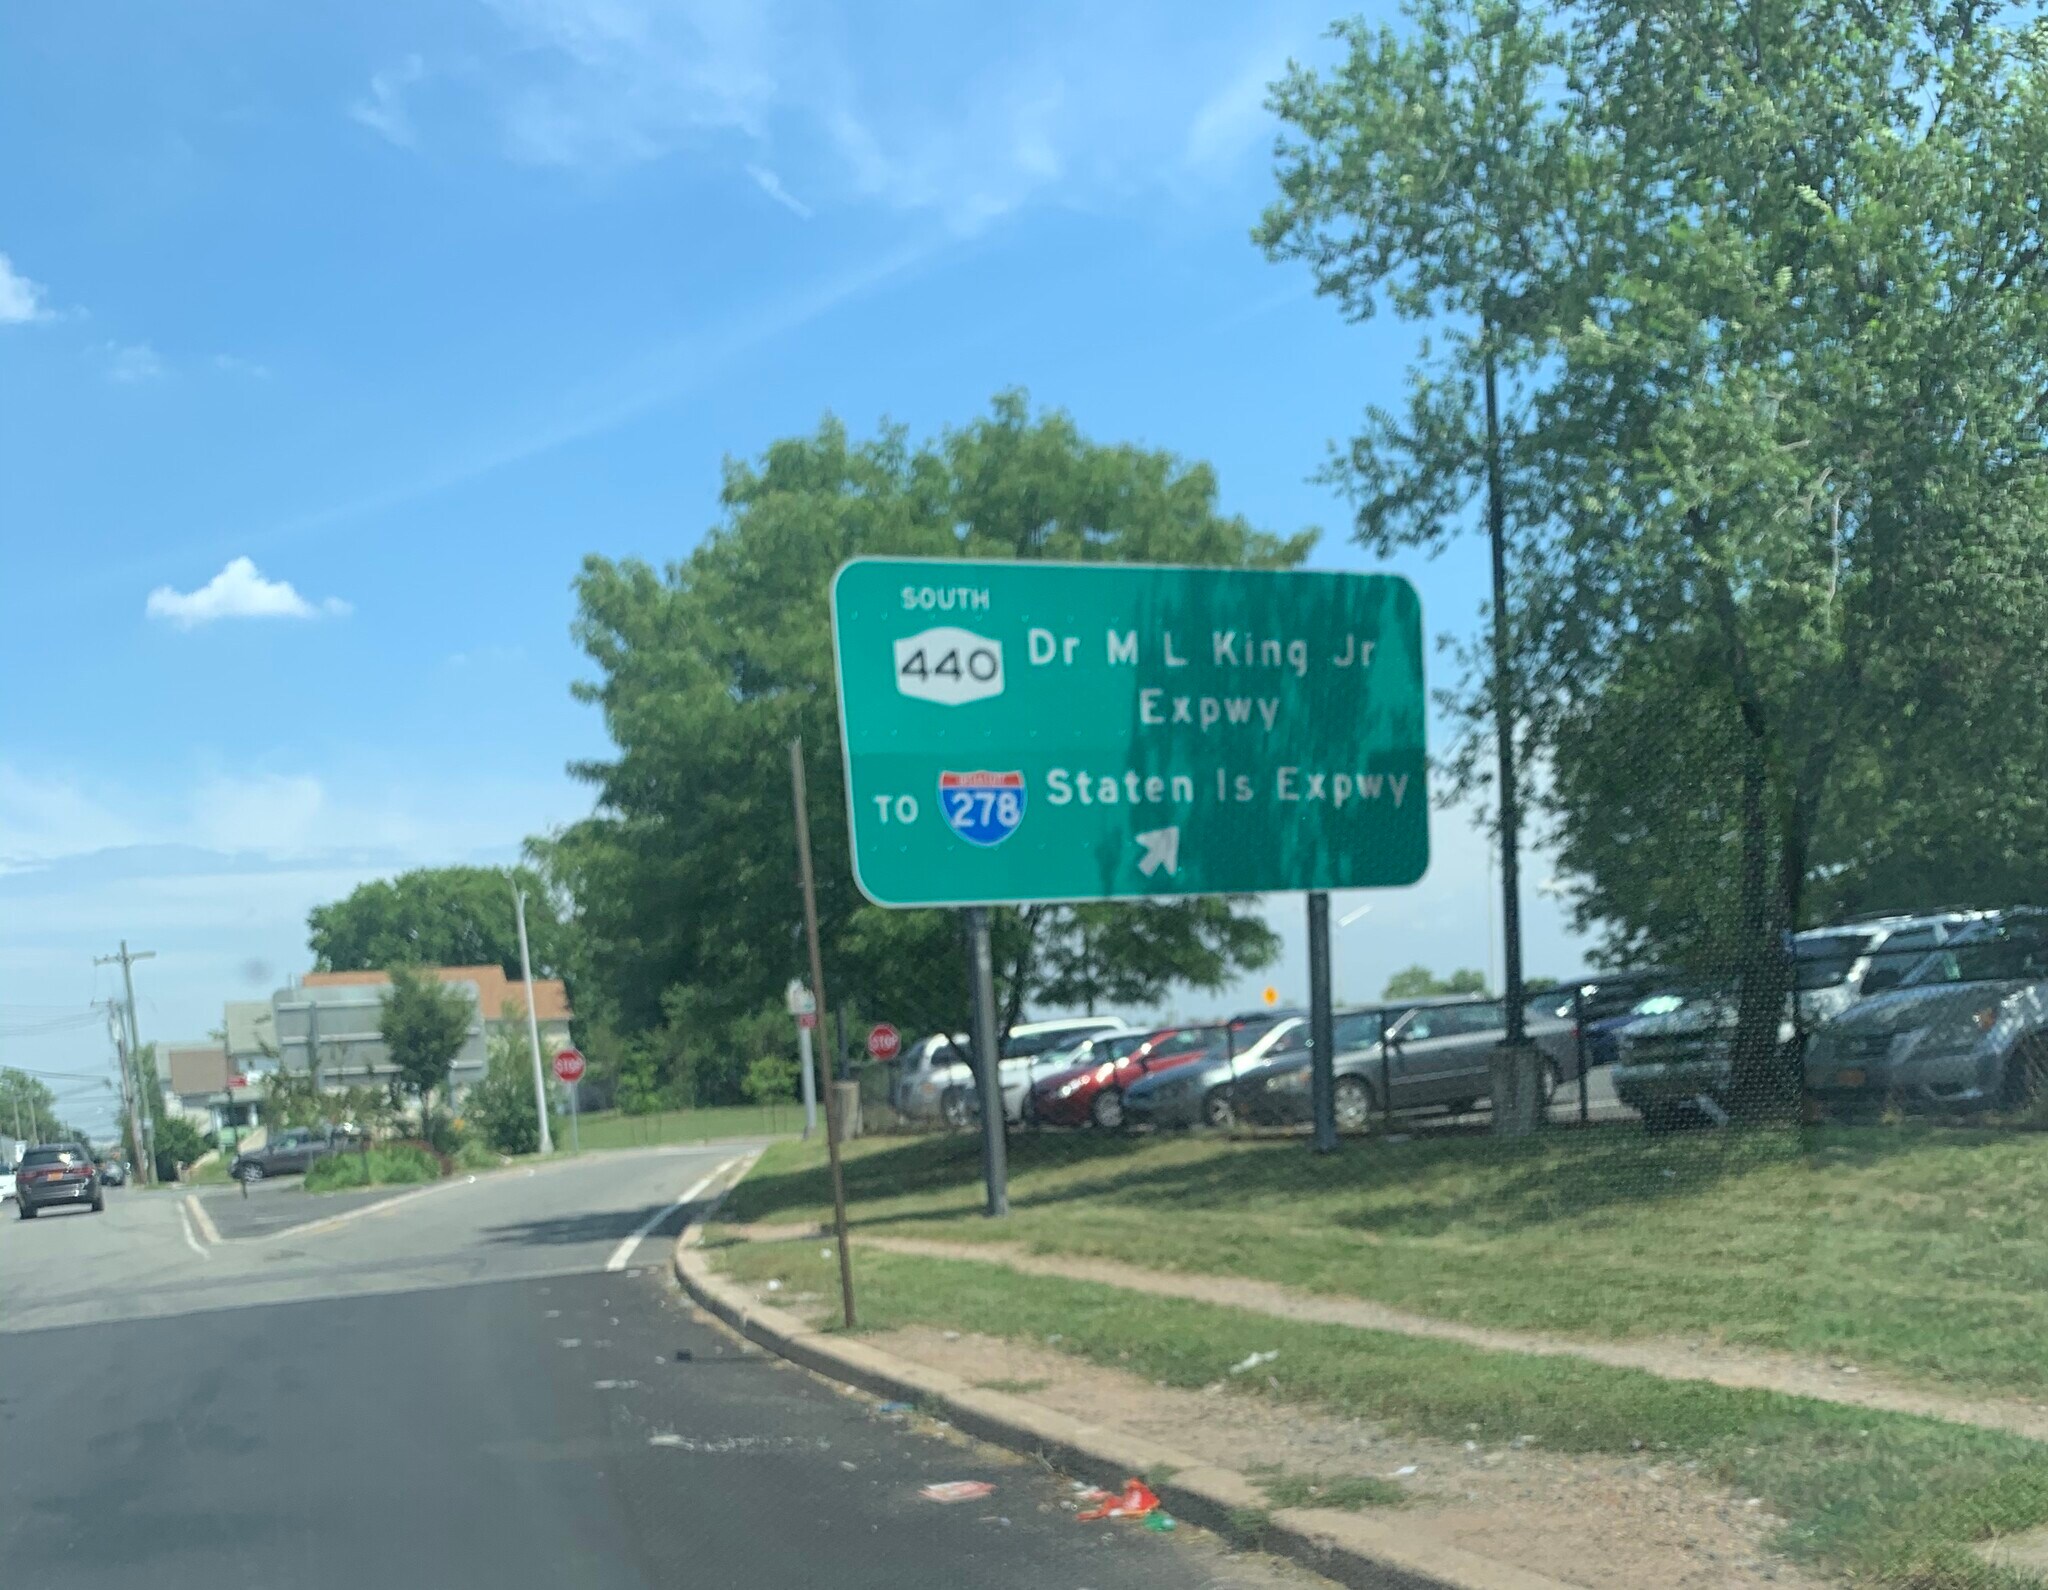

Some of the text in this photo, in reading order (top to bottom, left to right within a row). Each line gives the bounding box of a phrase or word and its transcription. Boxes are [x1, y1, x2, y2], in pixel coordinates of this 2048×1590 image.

[901, 587, 990, 612] SOUTH
[901, 648, 999, 684] 440
[1028, 628, 1375, 675] Dr M L King Jr
[1140, 688, 1279, 731] Expwy
[1047, 767, 1409, 809] Staten Is Expwy
[873, 795, 919, 824] TO
[951, 791, 1021, 828] 278
[870, 1034, 898, 1049] STOP
[555, 1059, 584, 1072] STOP
